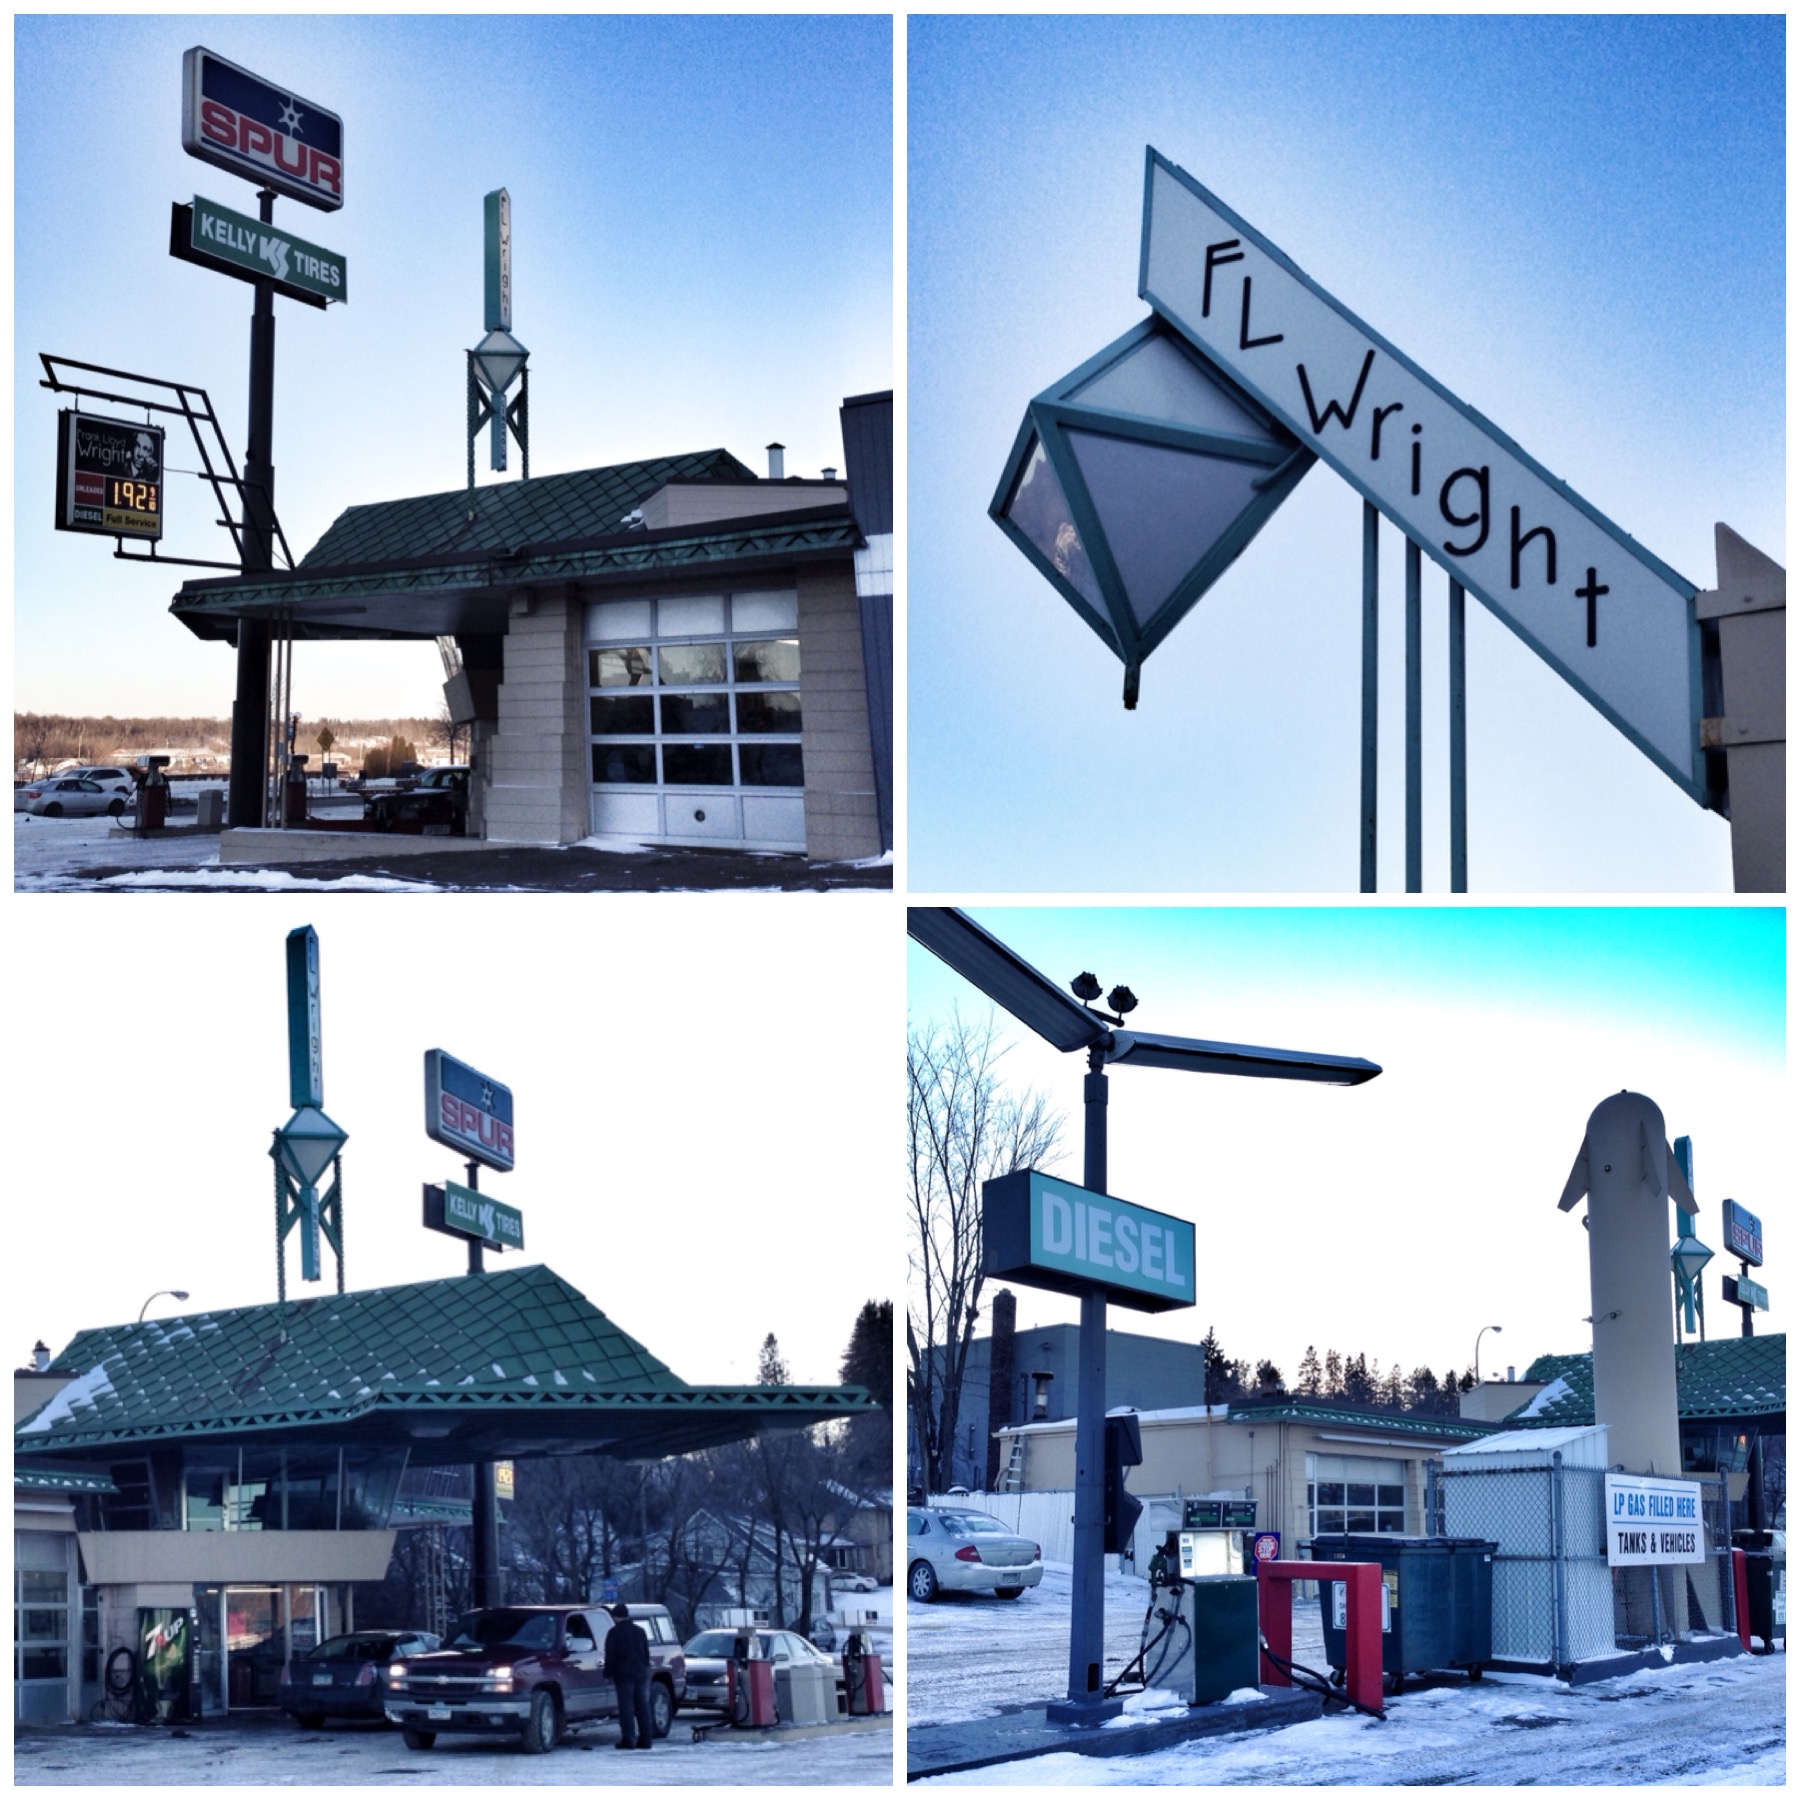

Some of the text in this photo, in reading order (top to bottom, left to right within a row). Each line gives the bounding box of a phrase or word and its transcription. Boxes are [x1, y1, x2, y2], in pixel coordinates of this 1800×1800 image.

[201, 99, 341, 194] SPUR
[201, 212, 257, 254] KELLY
[294, 250, 341, 287] TIRES
[77, 439, 125, 467] Wright
[1202, 239, 1609, 648] FL Wright
[74, 508, 103, 521] DIESEL
[106, 513, 157, 529] Full Service
[440, 1093, 514, 1157] SPUR
[450, 1194, 477, 1222] KELLY
[496, 1212, 520, 1239] TIRES
[1041, 1190, 1186, 1287] DIESEL
[1733, 1224, 1763, 1259] SPUR
[1614, 1492, 1696, 1518] LP GAS FILLED HERE
[1618, 1532, 1696, 1554] TANKS & VEHICLES
